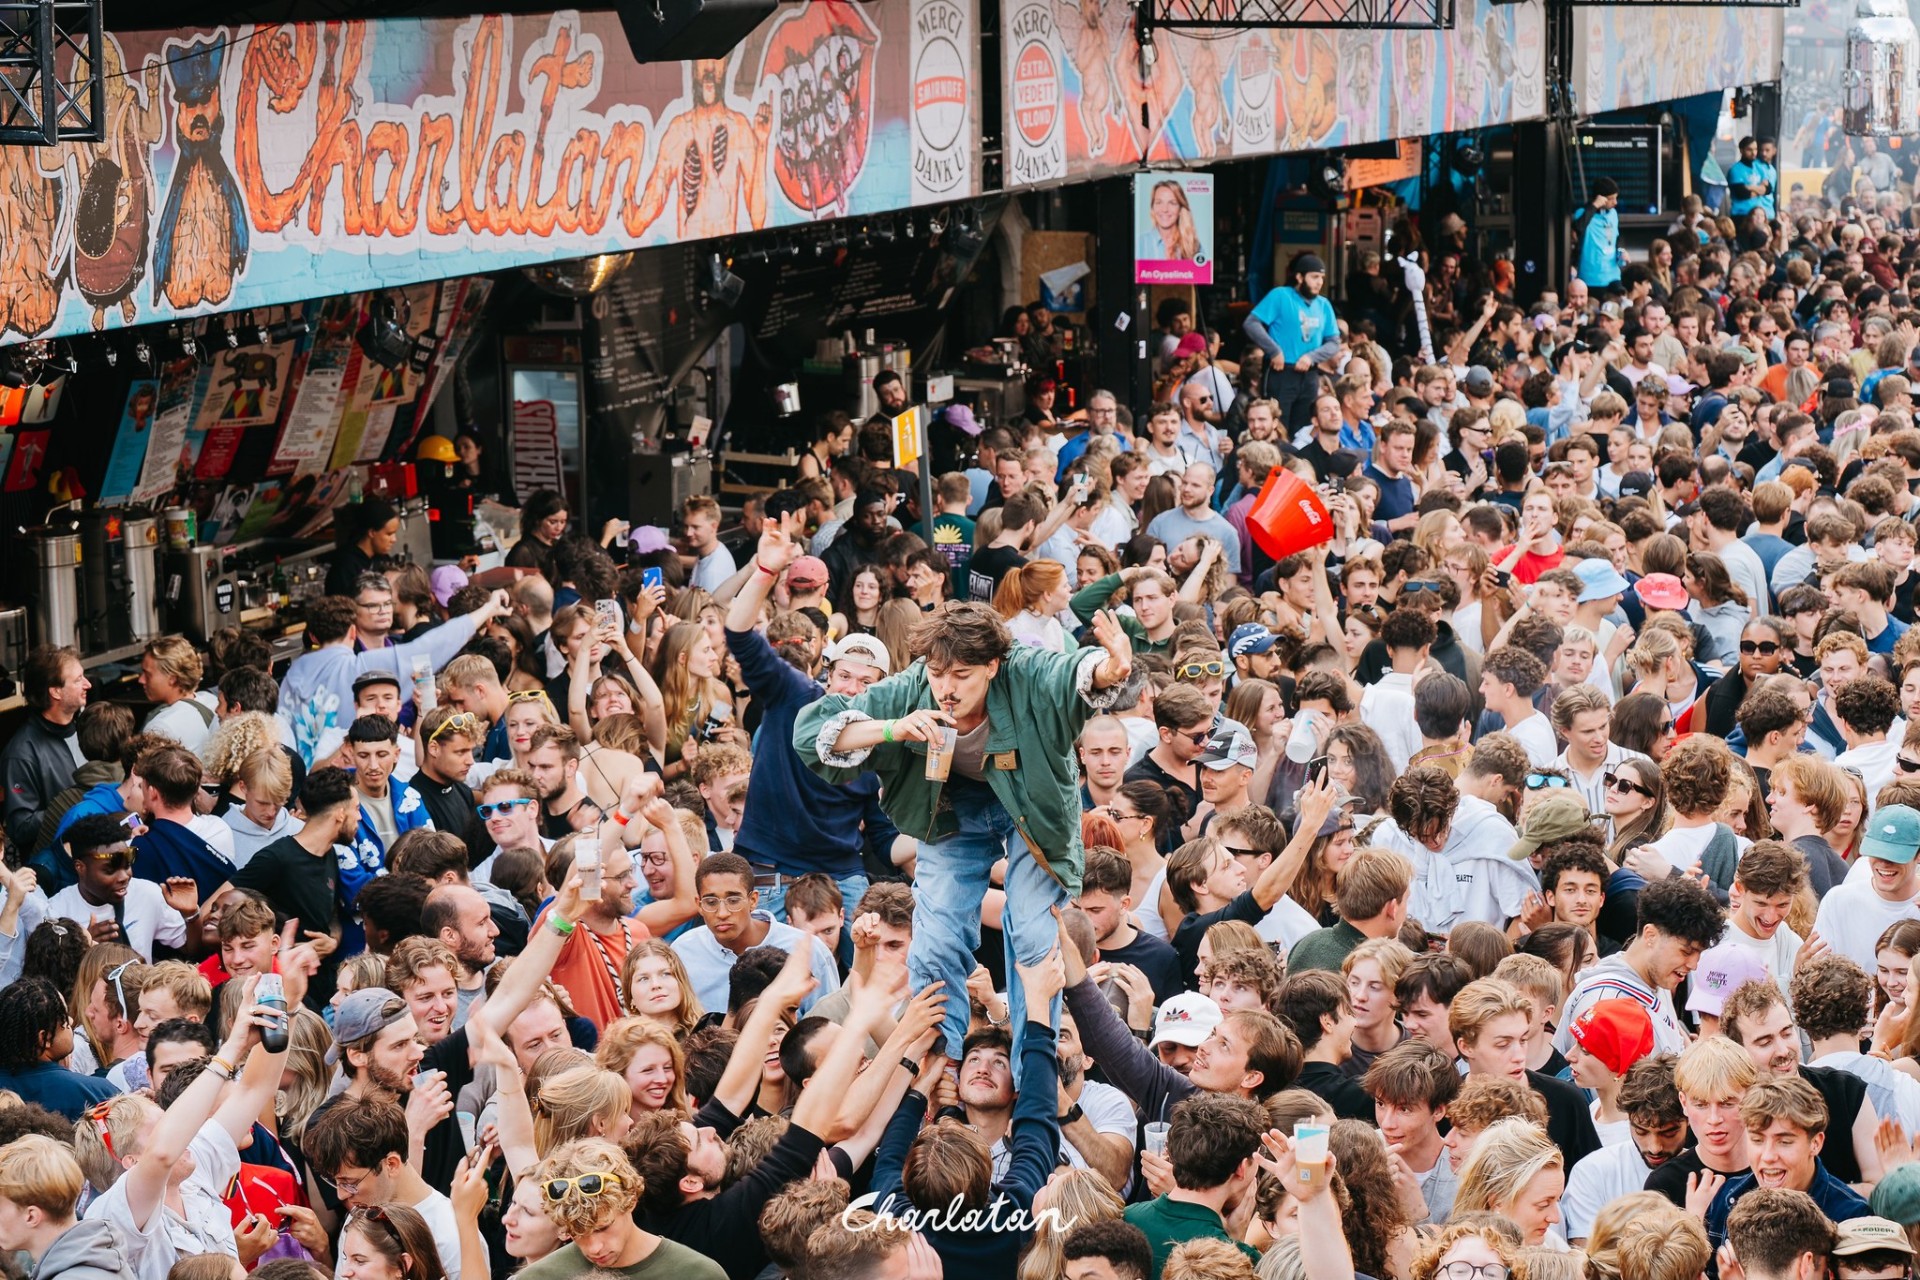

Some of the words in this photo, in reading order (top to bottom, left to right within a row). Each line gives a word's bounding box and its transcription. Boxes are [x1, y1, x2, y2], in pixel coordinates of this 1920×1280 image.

[918, 6, 963, 41] MERCI
[1013, 10, 1052, 46] MERCI
[1021, 60, 1050, 77] EXTRA
[918, 79, 962, 104] SMIRNOFF
[1018, 83, 1055, 104] VEDETT
[234, 14, 650, 238] Charlatan
[1023, 109, 1051, 128] BLOND
[915, 148, 953, 184] DANK
[954, 146, 966, 172] U
[1015, 148, 1050, 179] DANK
[1051, 140, 1062, 164] U
[1140, 270, 1152, 279] An
